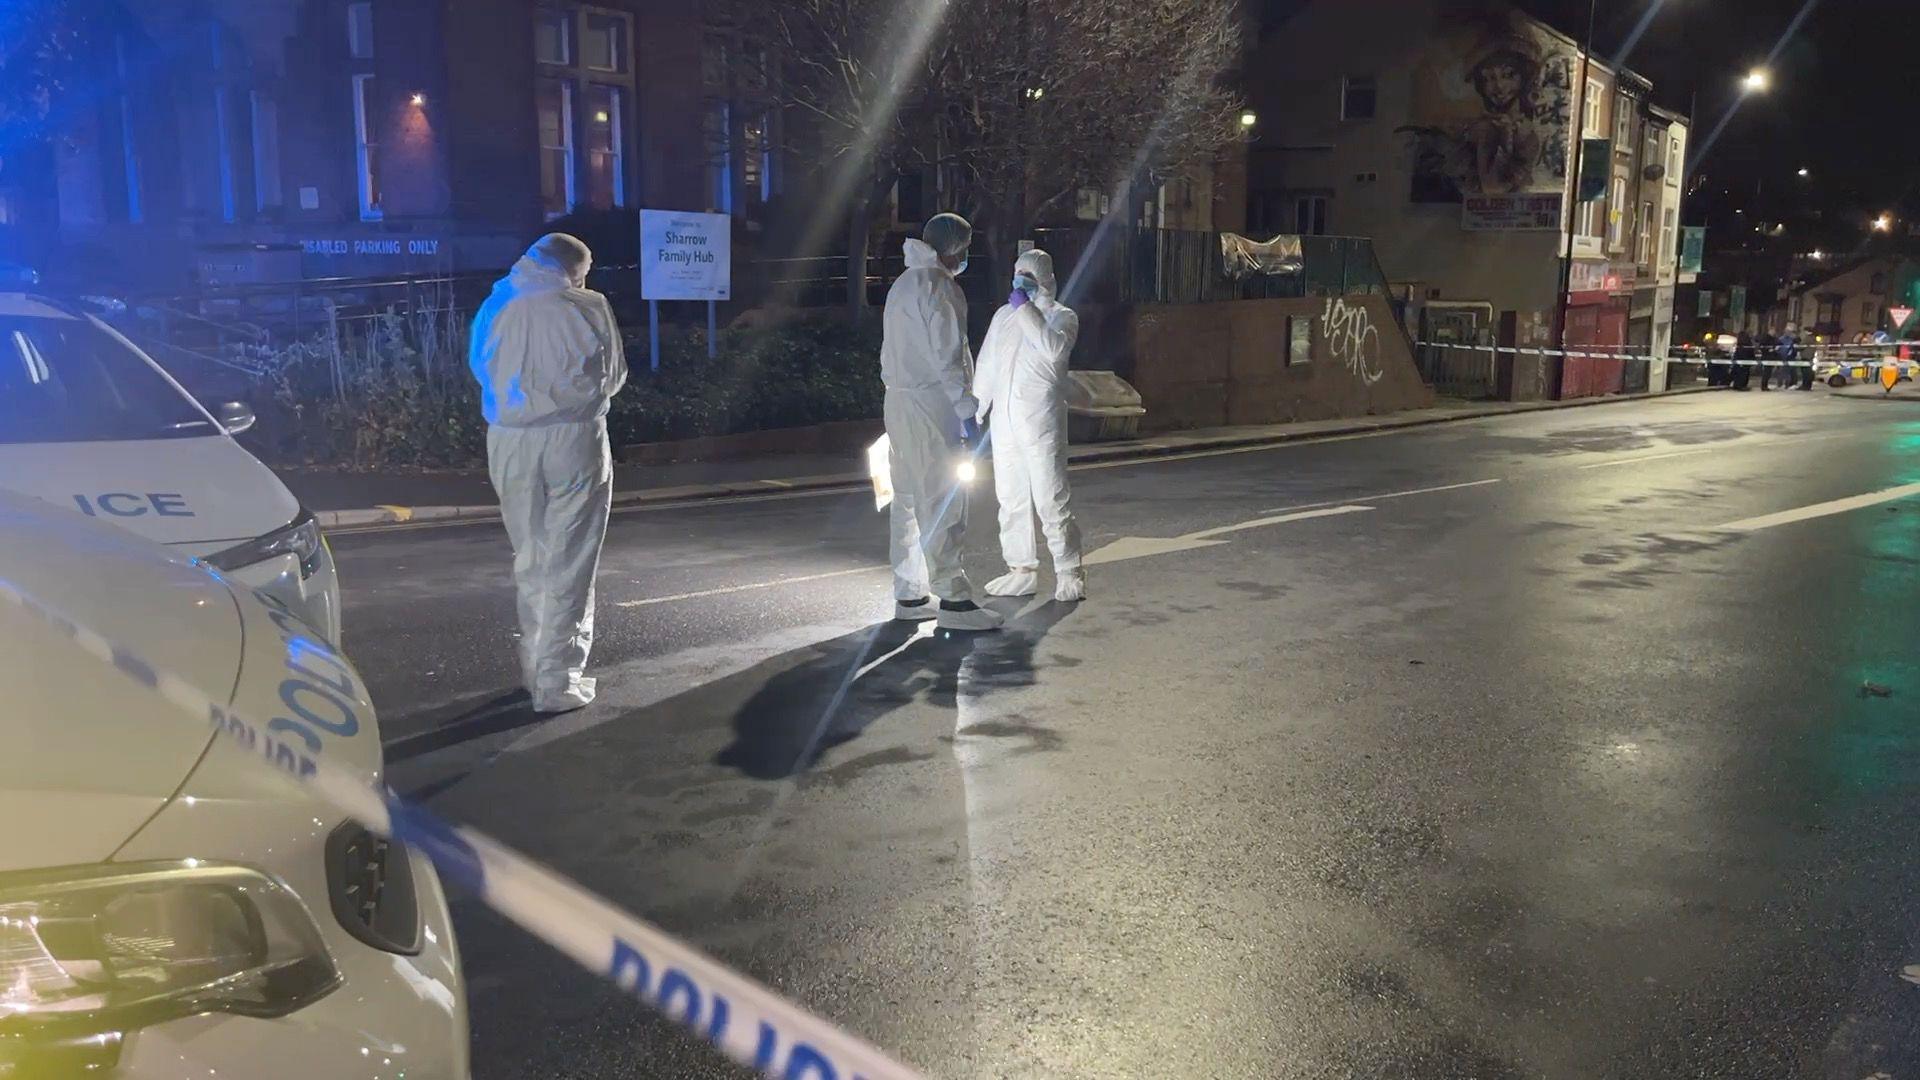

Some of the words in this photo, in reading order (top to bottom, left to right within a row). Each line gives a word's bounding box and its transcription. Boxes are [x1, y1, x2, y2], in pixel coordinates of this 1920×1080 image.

[354, 239, 401, 255] PARKING
[408, 240, 438, 255] ONLY
[665, 231, 708, 246] Sharrow
[658, 249, 691, 266] Family
[693, 250, 714, 263] Hub
[73, 493, 195, 517] ICE
[611, 935, 868, 1080] POLIC
